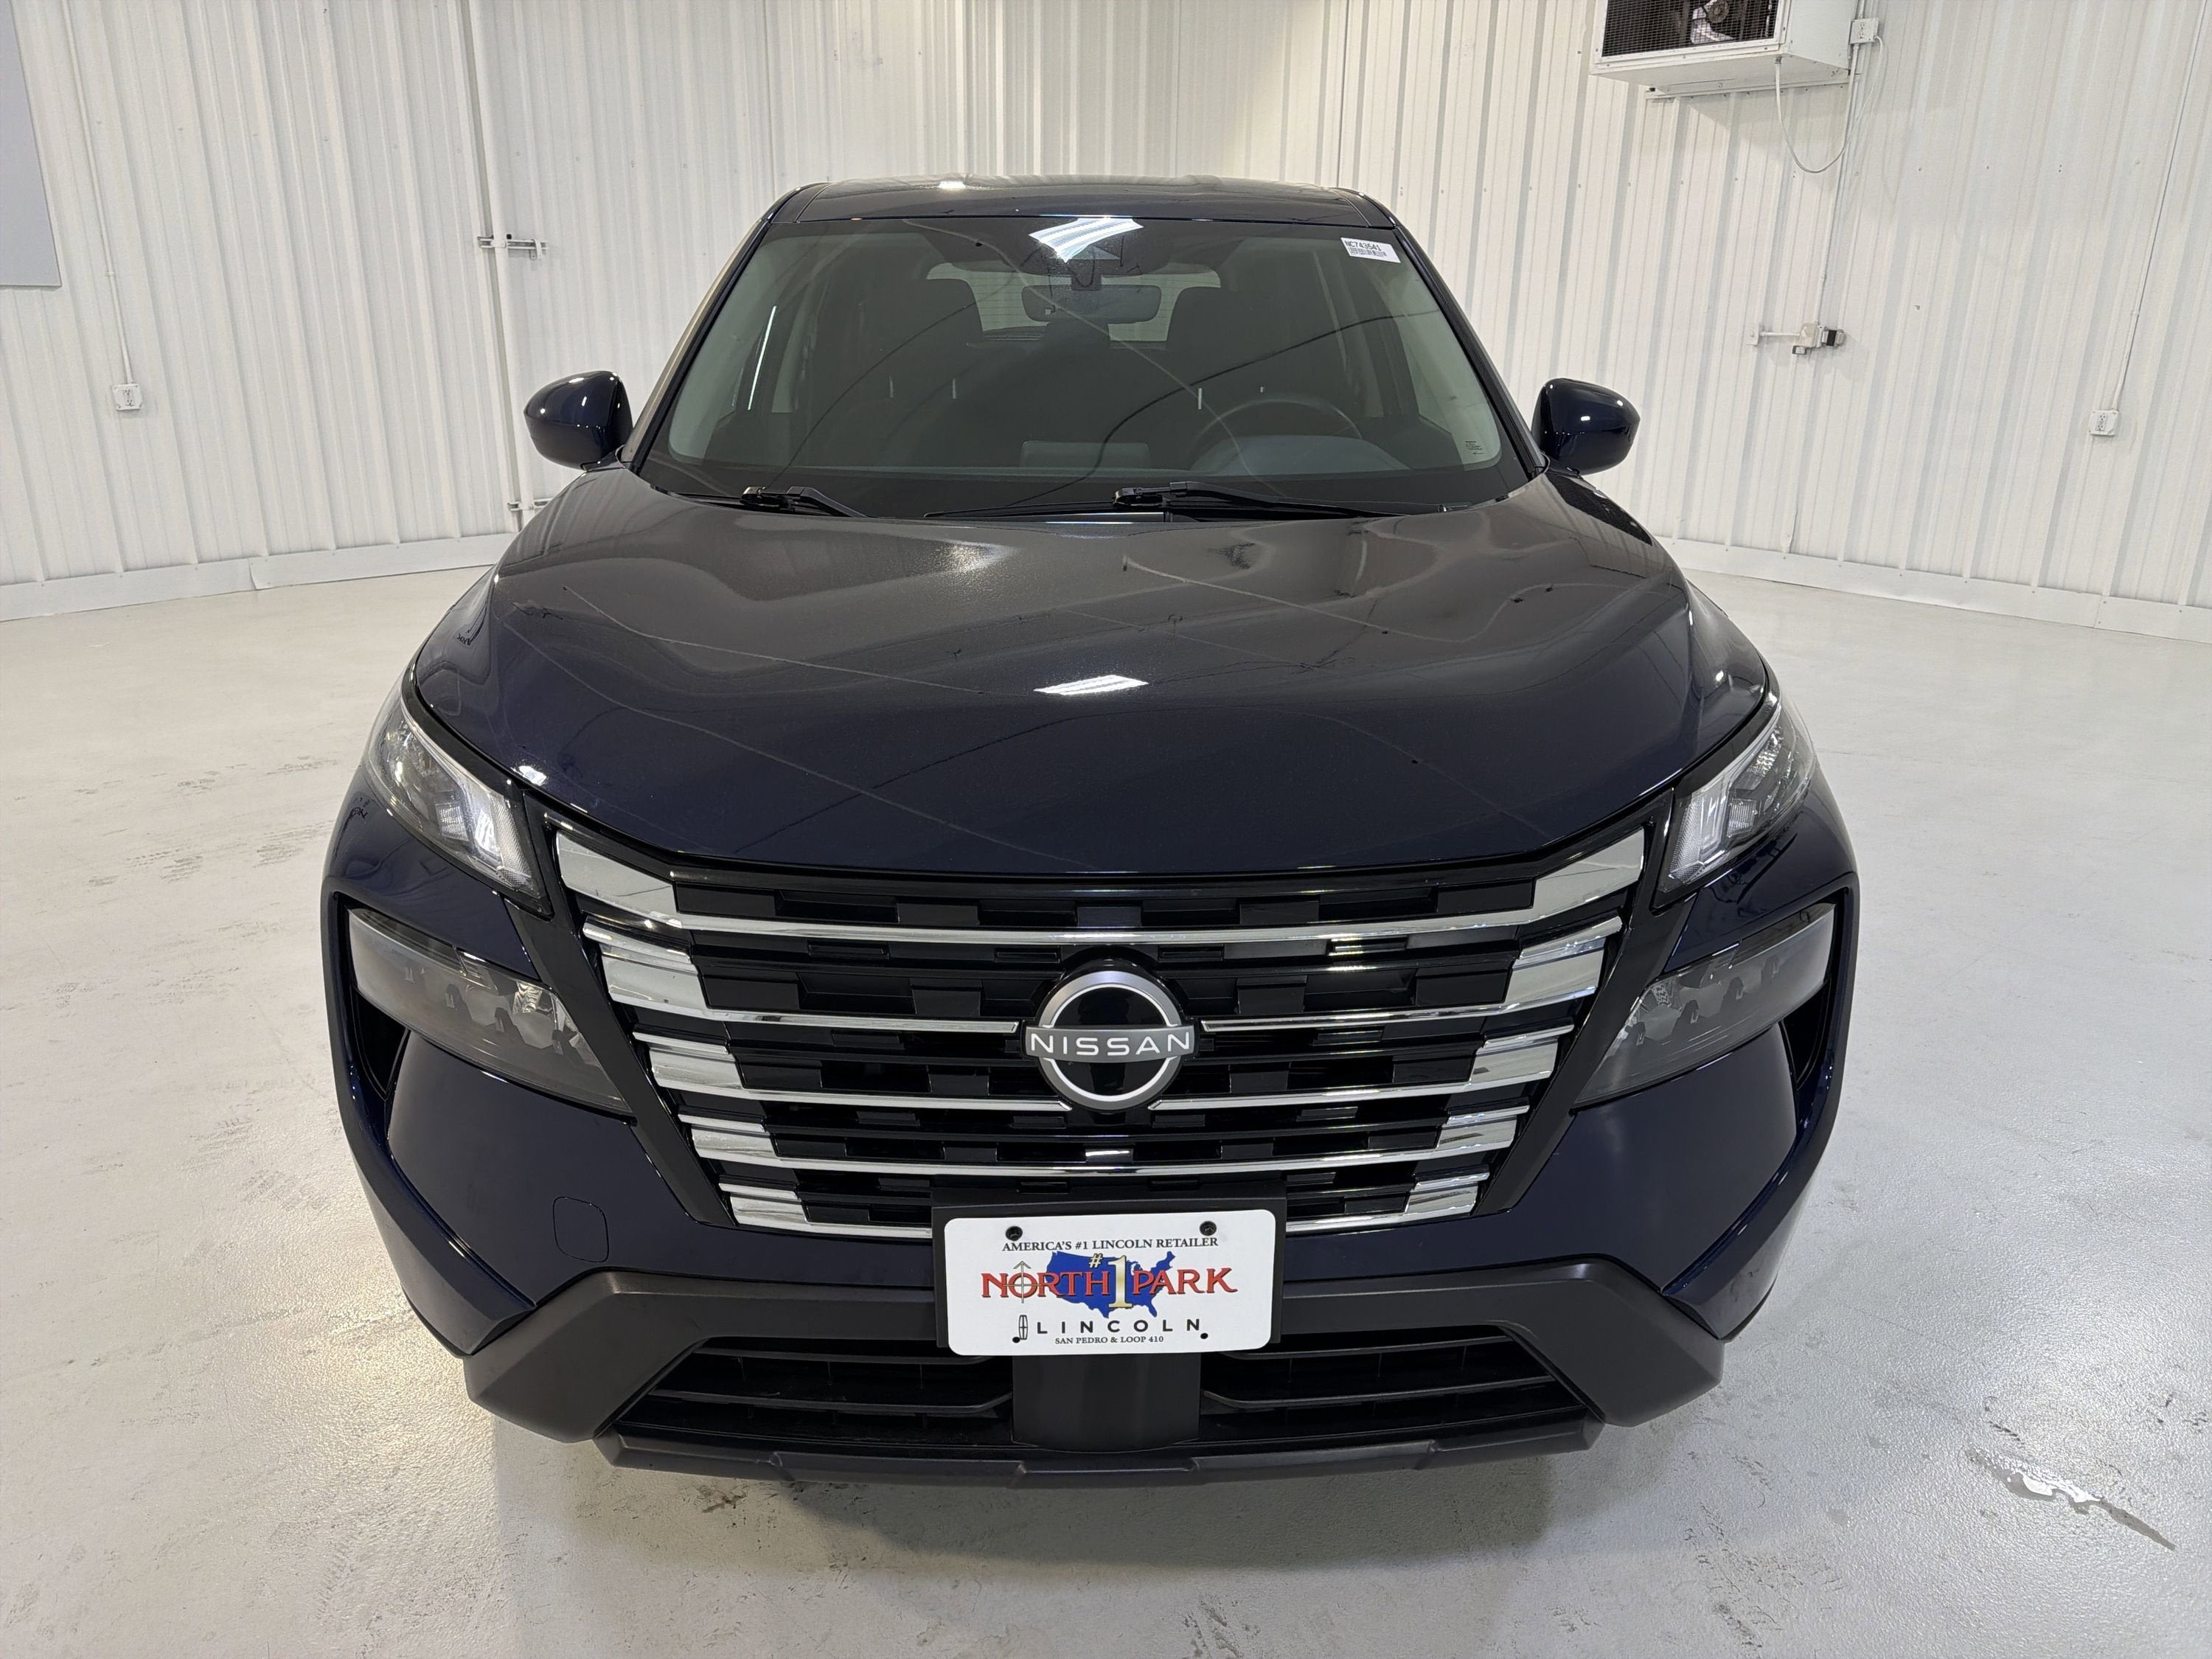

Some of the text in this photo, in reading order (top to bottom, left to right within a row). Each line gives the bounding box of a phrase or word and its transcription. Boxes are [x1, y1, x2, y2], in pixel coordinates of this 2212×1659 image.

[1031, 1032, 1189, 1056] NISSAN
[1002, 1237, 1219, 1251] AMERICA'S #1 LINCOLN RETAILER
[981, 1267, 1239, 1298] NORTH PARK
[1037, 1319, 1200, 1335] LINCOLN
